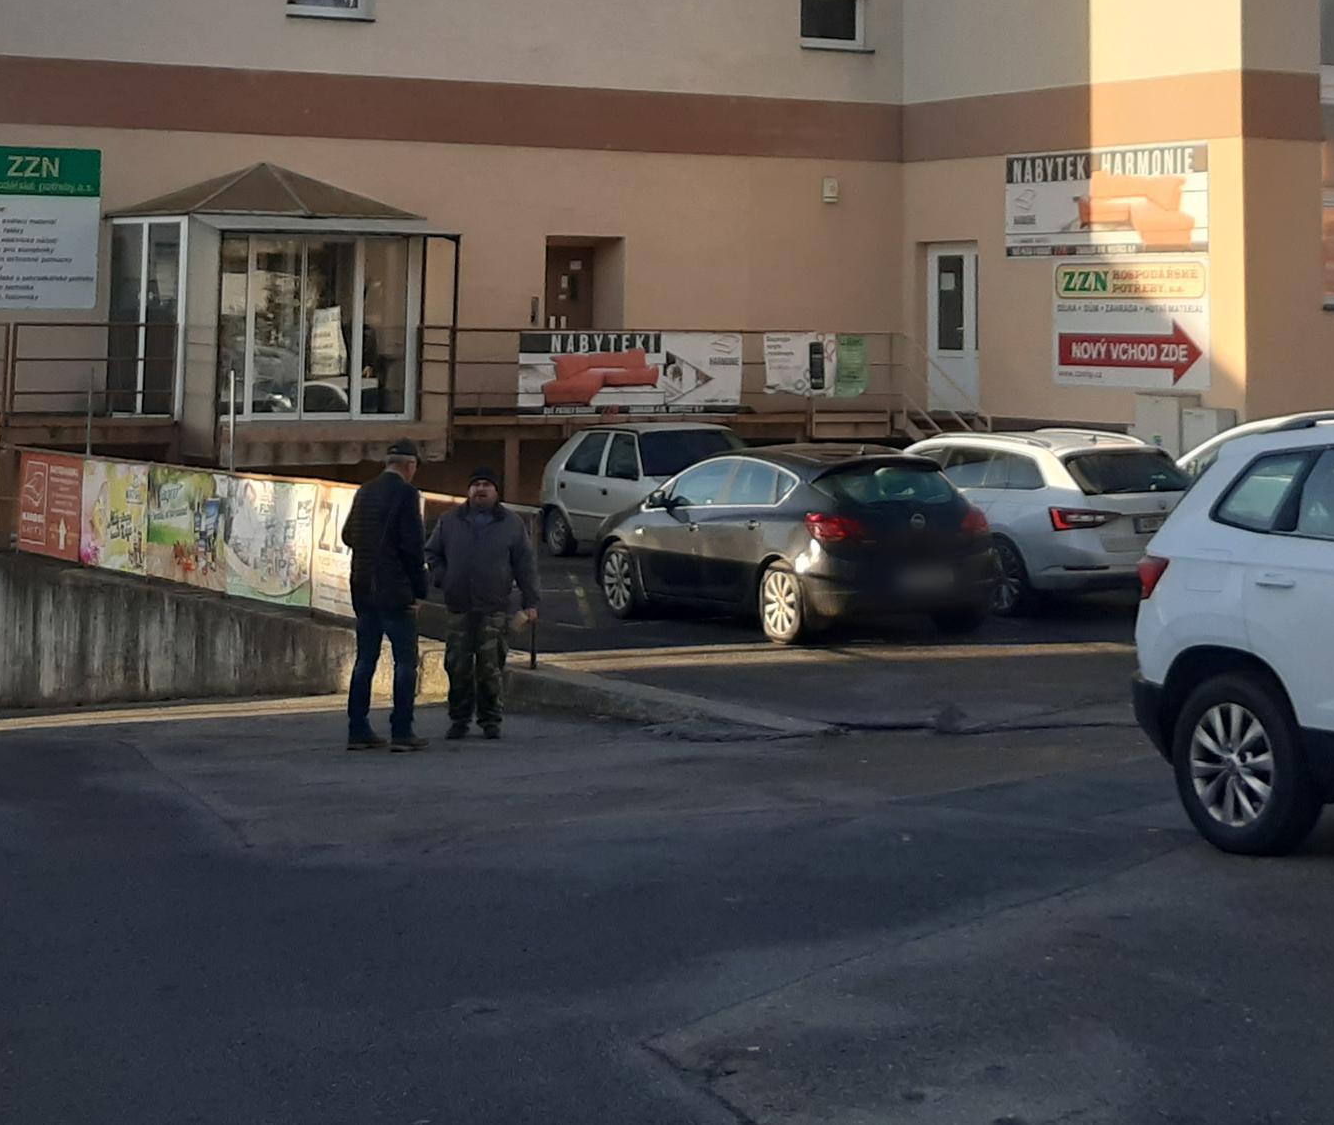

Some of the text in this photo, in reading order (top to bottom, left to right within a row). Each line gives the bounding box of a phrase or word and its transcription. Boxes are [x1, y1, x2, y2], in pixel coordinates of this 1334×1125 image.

[7, 155, 60, 178] ZZN
[1101, 147, 1194, 175] HARMONIE
[1062, 270, 1109, 292] ZZN
[1071, 338, 1189, 362] NOVÝ VCHOD ZDE
